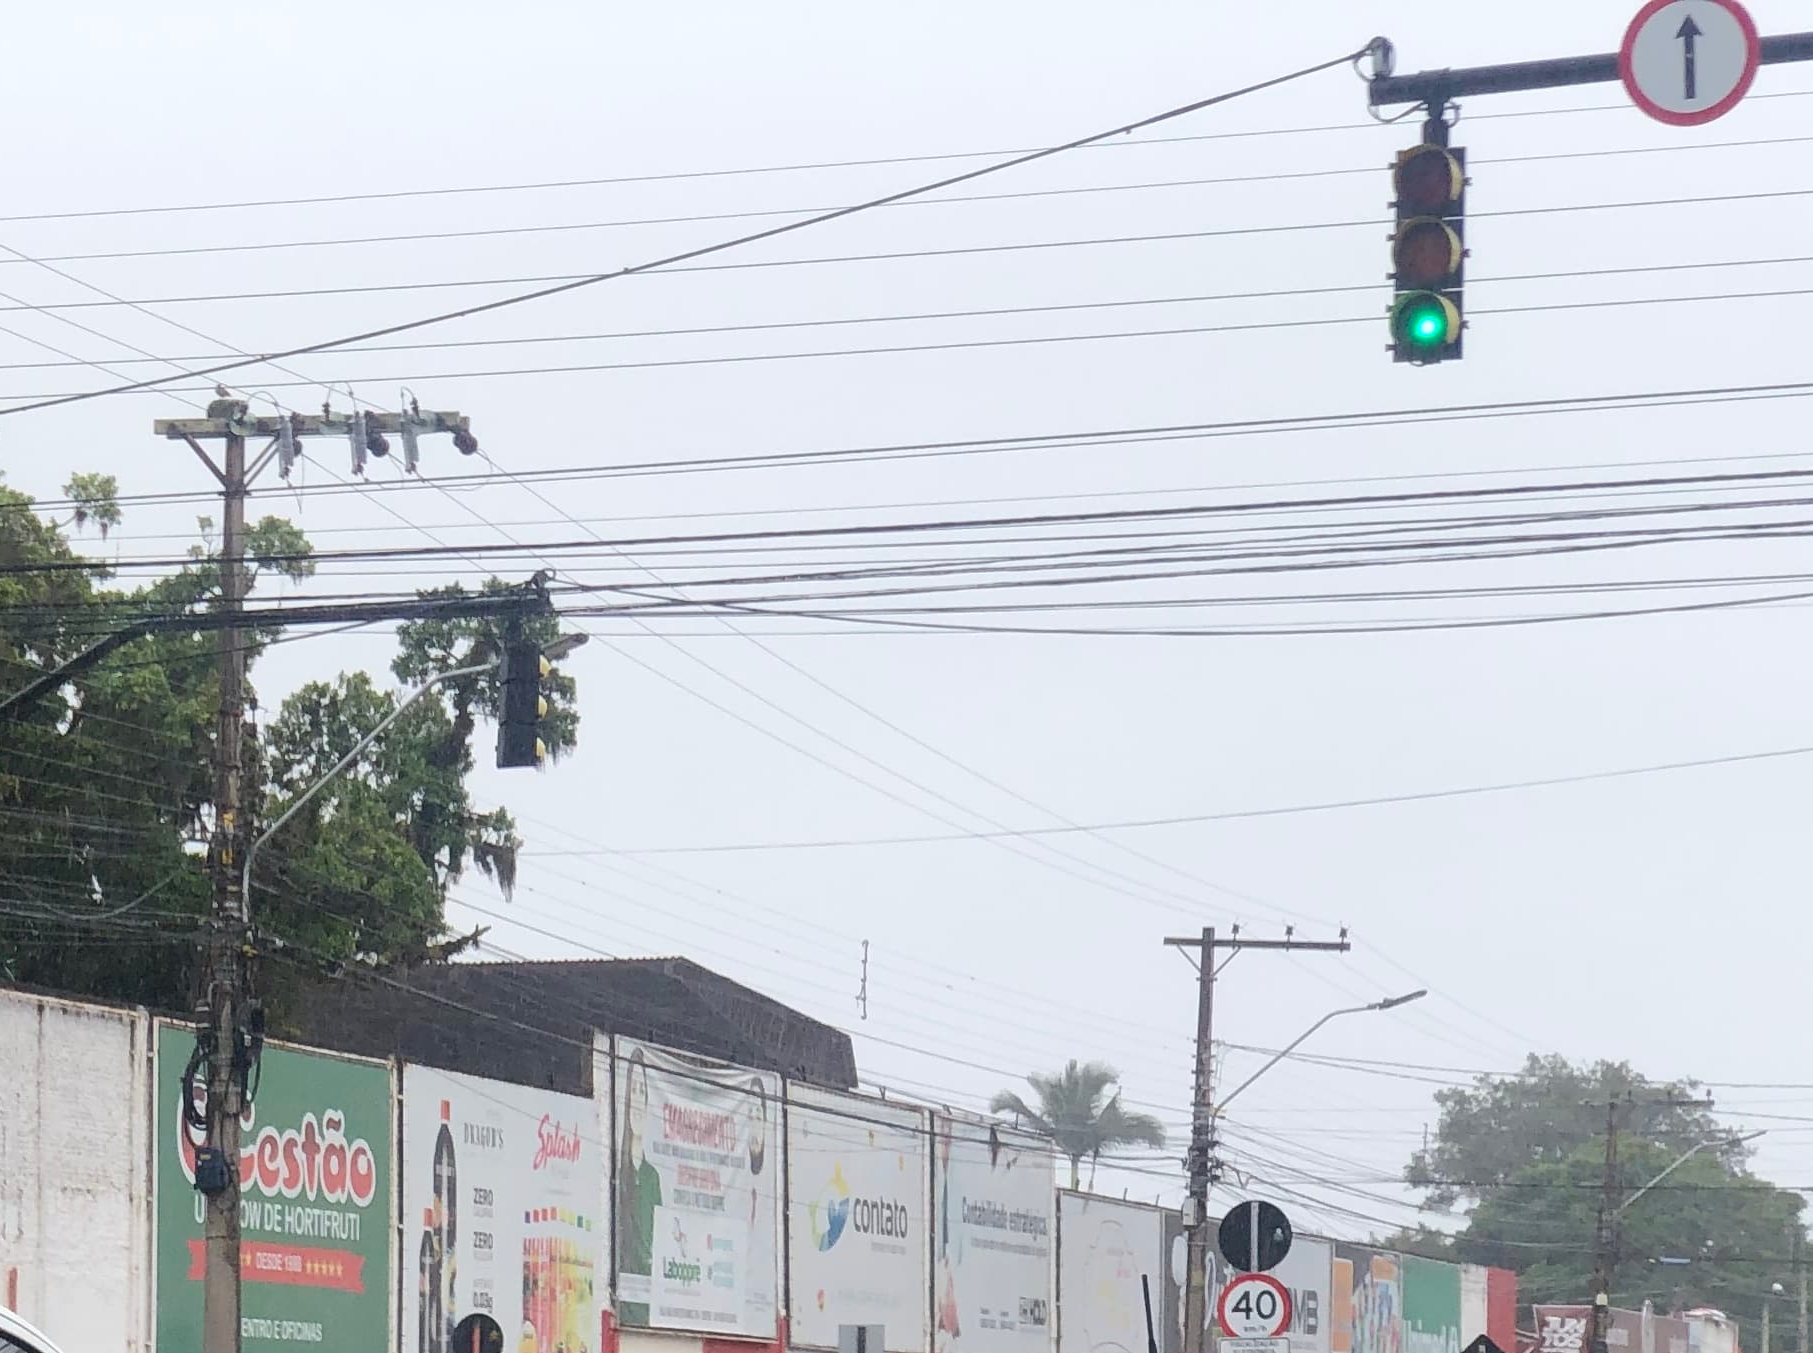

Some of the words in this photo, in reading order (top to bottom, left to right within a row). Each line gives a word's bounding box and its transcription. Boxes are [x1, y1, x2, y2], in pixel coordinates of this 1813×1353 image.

[532, 1112, 583, 1171] Splash
[473, 1186, 494, 1206] ZERO
[264, 1204, 282, 1233] DE
[285, 1207, 361, 1242] HORTIFRUTI
[853, 1195, 909, 1239] contato
[473, 1230, 494, 1250] ZERO
[256, 1252, 283, 1272] DESDE
[1231, 1289, 1277, 1321] 40
[240, 1317, 274, 1340] ENTRO
